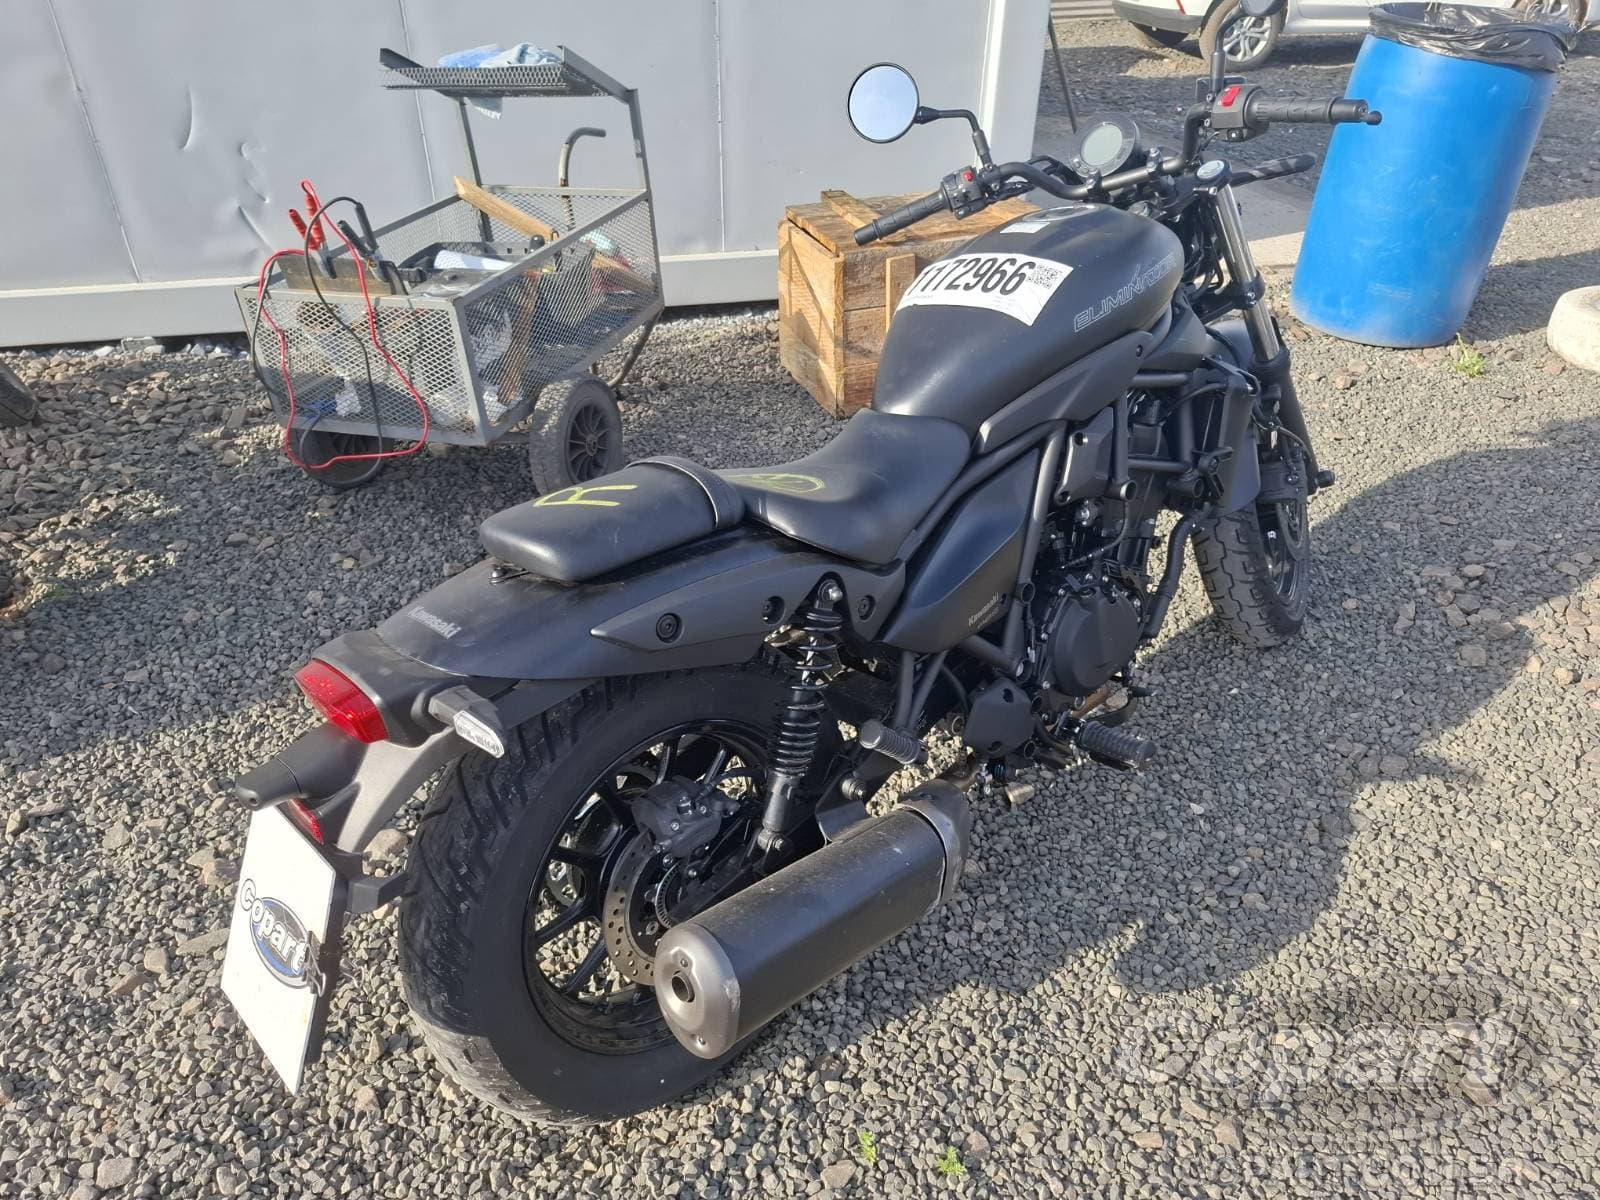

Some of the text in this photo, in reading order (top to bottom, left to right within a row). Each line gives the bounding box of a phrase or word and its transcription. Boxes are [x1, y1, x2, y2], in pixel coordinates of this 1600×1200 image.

[907, 257, 1036, 296] 1172966
[532, 484, 638, 508] R
[406, 604, 461, 640] Kawasaki
[240, 877, 308, 976] Copart
